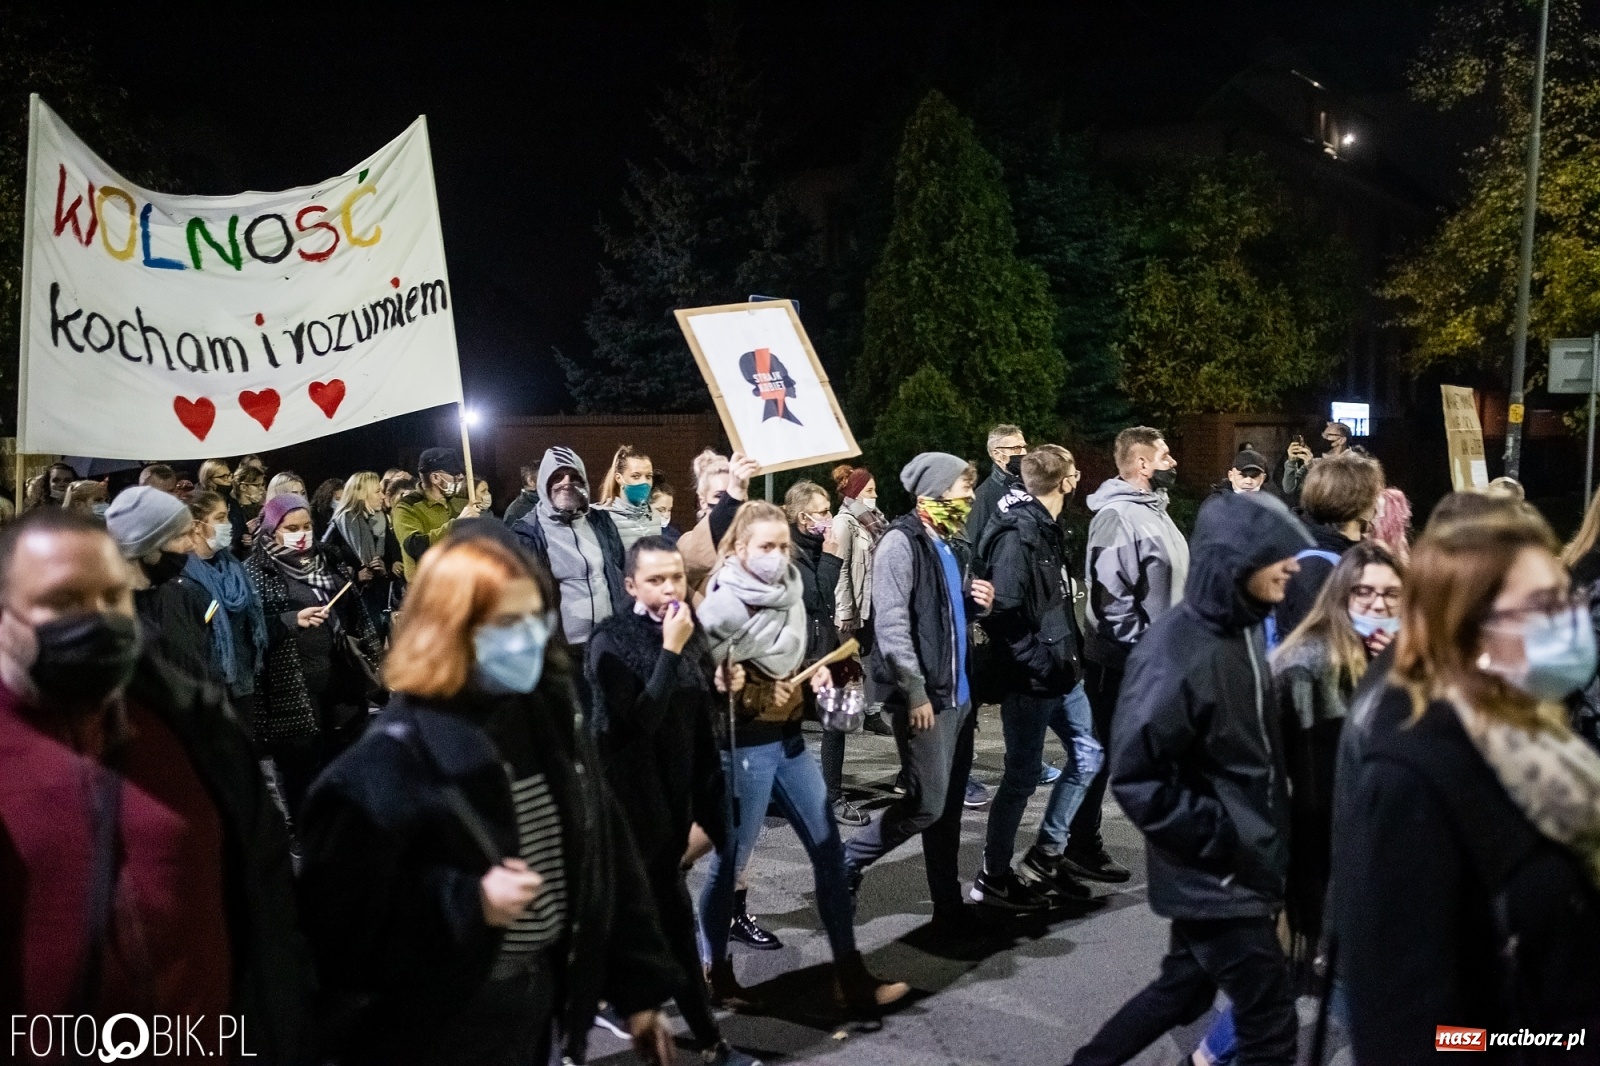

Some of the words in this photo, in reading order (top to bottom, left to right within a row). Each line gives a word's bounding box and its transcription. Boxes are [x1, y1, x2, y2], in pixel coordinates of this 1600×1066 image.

[50, 282, 249, 373] kocham
[255, 312, 281, 368] i
[283, 276, 448, 365] rozumiem
[752, 371, 783, 384] STRAJK
